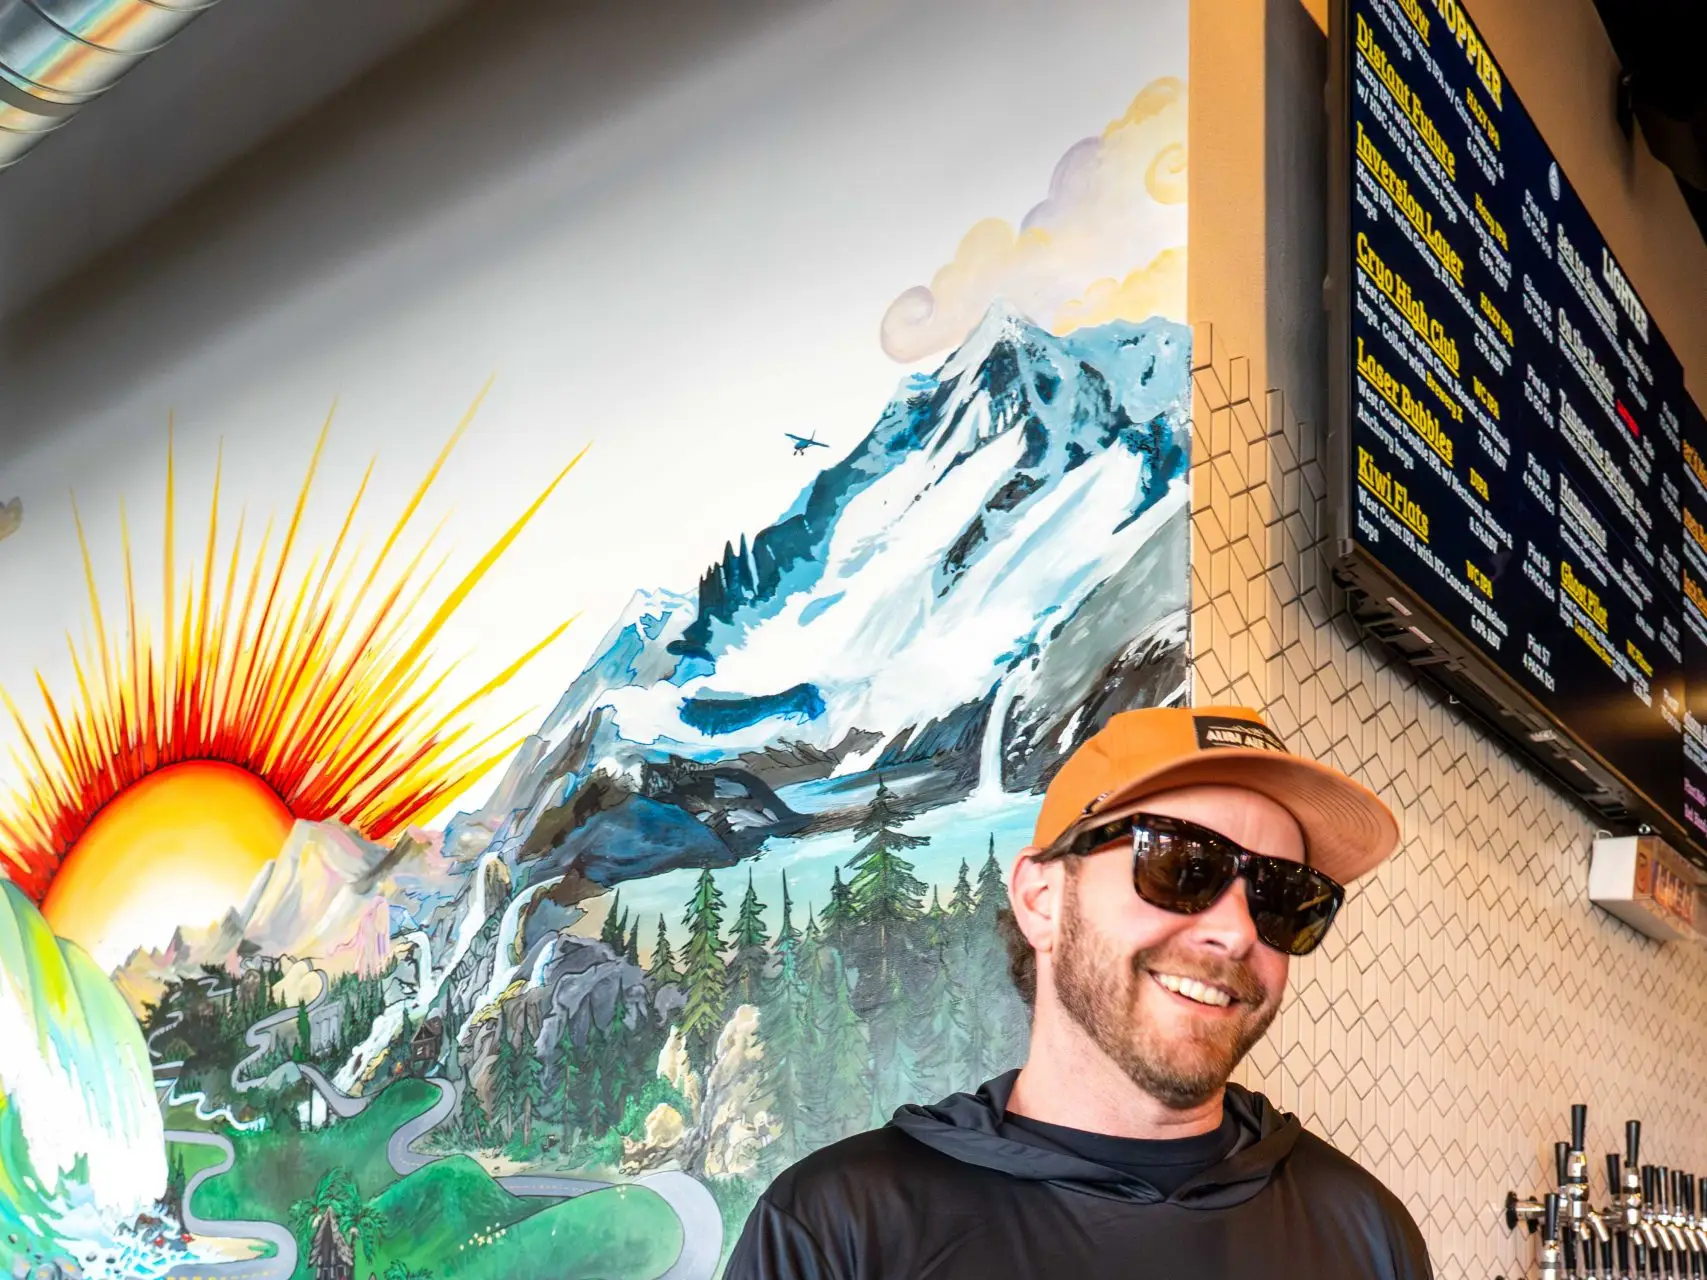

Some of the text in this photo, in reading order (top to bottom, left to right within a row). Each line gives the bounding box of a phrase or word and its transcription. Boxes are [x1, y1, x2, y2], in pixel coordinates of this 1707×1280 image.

[1357, 10, 1409, 113] Distant
[1412, 90, 1454, 177] Future
[1357, 50, 1377, 98] Hazy
[1380, 82, 1392, 116] IPA
[1394, 102, 1411, 142] with
[1413, 128, 1439, 181] Toasted
[1357, 158, 1378, 204] Hazy
[1380, 188, 1392, 219] IPA
[1394, 206, 1411, 243] with
[1357, 116, 1463, 288] Inversion Layer
[1357, 182, 1377, 227] hops
[1357, 228, 1459, 373] Cryo High Club
[1357, 266, 1377, 305] West
[1379, 292, 1400, 332] Coast
[1402, 319, 1414, 348] IPA
[1416, 335, 1432, 369] with
[1357, 292, 1379, 335] hops.
[1383, 320, 1406, 362] Collab
[1409, 350, 1425, 383] with
[1602, 245, 1648, 347] LIGHTER
[1357, 335, 1452, 463] Laser Bubbles
[1357, 374, 1377, 410] West
[1379, 397, 1400, 435] Coast
[1402, 422, 1427, 463] Double
[1429, 450, 1440, 476] IPA
[1442, 464, 1450, 487] w/
[1358, 400, 1413, 475] Anchovy hops
[1358, 443, 1428, 538] Kiwi Flats
[1358, 509, 1378, 547] hops
[1358, 485, 1378, 518] West
[1380, 506, 1401, 540] Coast
[1403, 527, 1415, 553] IPA
[1417, 540, 1432, 569] with
[1434, 557, 1443, 579] NZ
